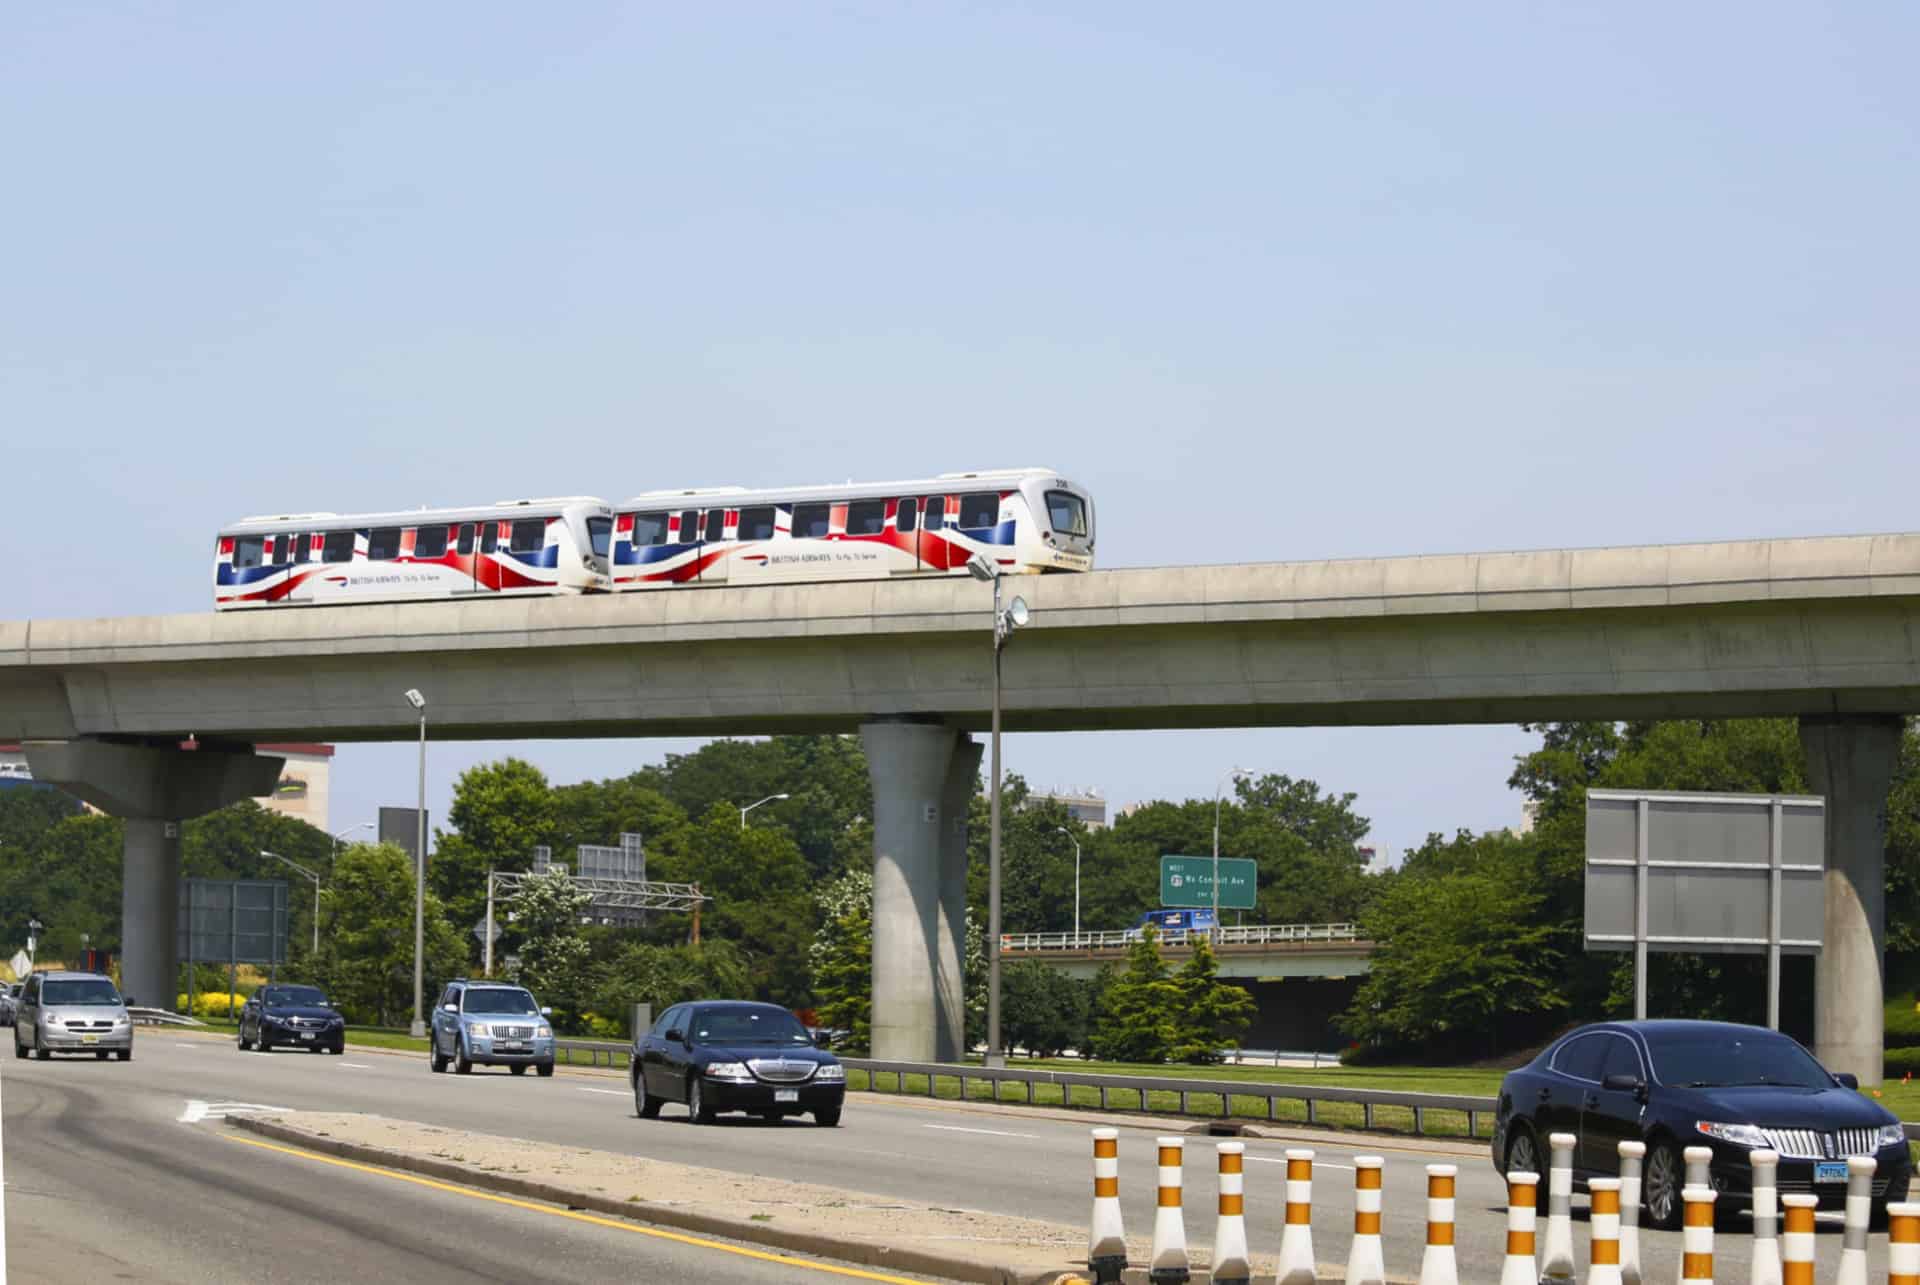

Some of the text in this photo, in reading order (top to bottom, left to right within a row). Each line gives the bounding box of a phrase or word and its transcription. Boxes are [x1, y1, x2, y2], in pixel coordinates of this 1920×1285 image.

[771, 554, 799, 563] BRITISH
[801, 553, 831, 562] AIRWAYS
[1198, 875, 1228, 885] Conuit
